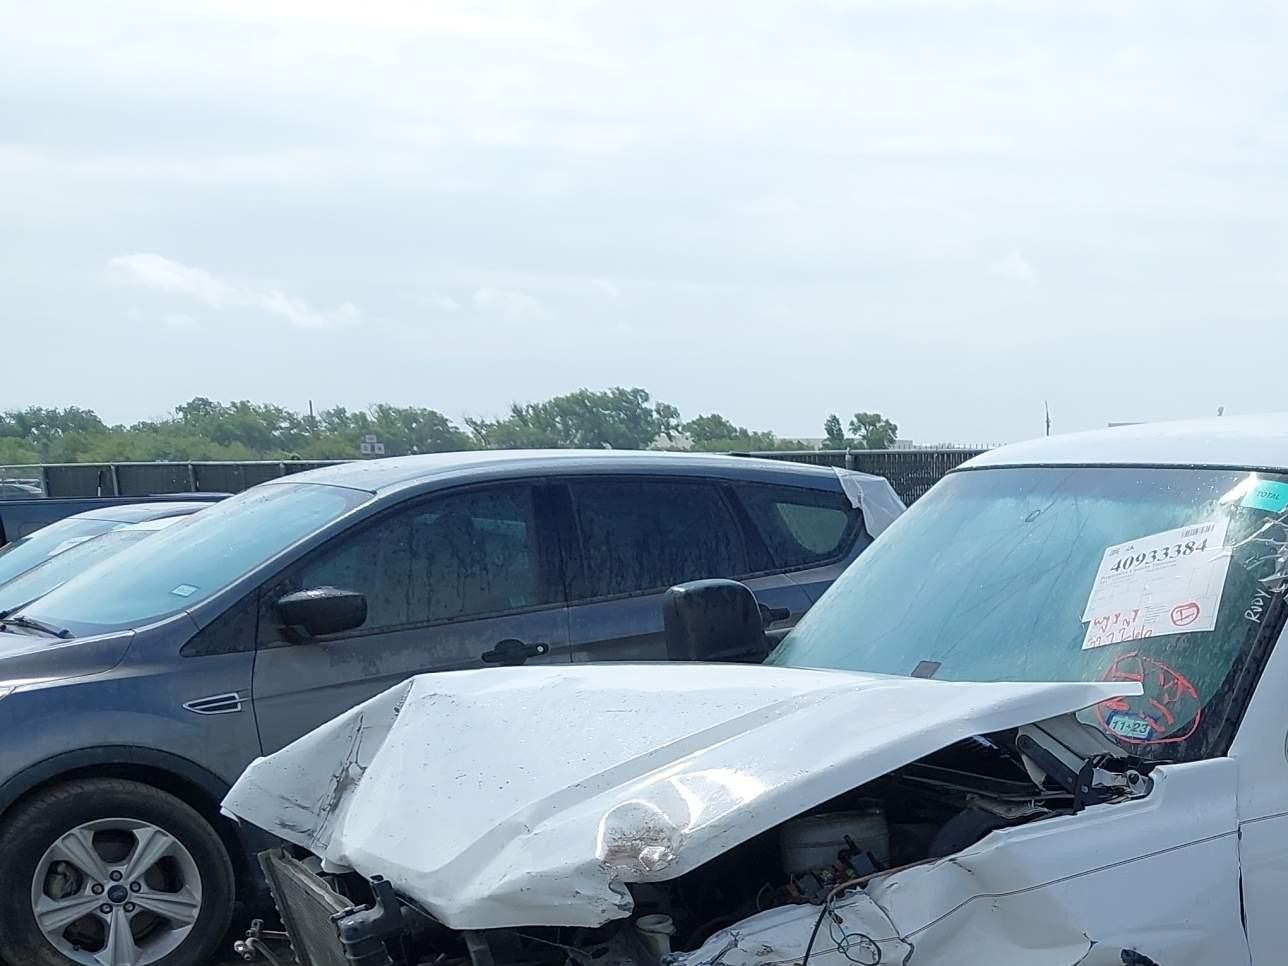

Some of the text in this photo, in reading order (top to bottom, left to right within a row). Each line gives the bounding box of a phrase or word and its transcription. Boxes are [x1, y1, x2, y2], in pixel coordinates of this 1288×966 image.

[1256, 490, 1280, 500] TOTAL
[1110, 538, 1208, 572] 40933384
[1244, 588, 1272, 623] RUDY
